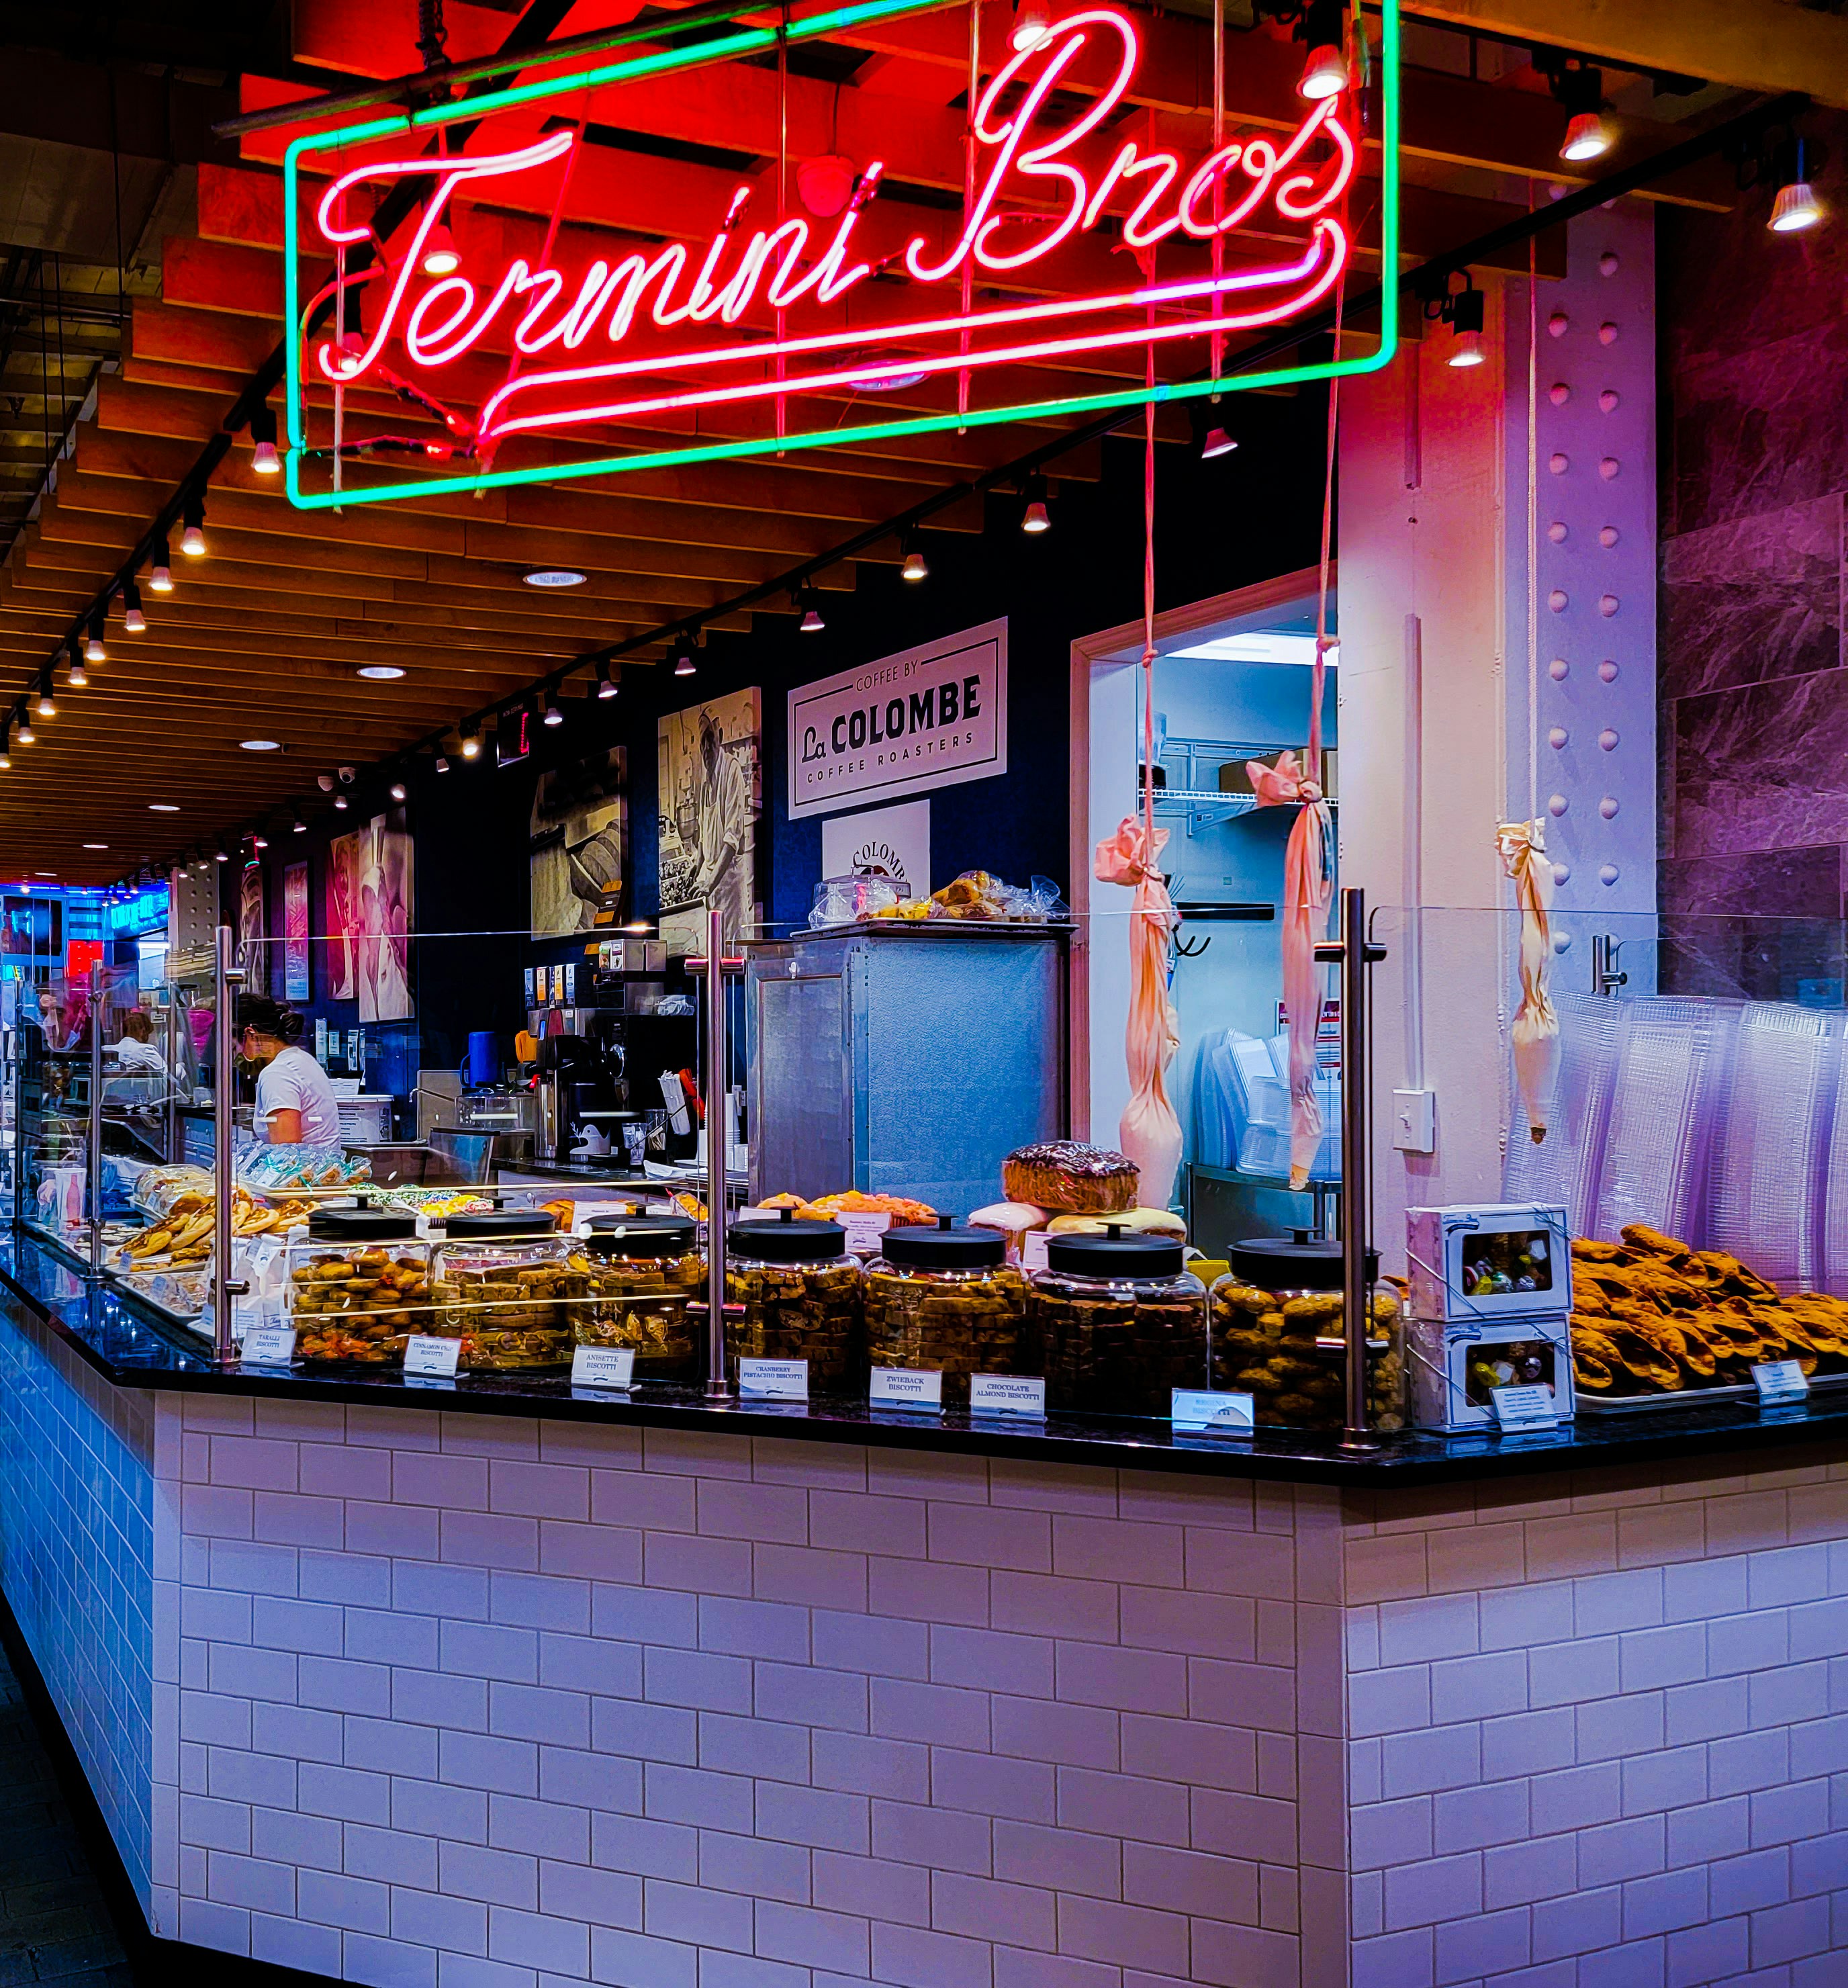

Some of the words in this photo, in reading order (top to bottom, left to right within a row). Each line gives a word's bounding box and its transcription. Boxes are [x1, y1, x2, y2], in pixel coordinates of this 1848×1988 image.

[318, 130, 874, 381] Termini
[907, 8, 1356, 281] Bros
[856, 666, 898, 692] COFFEE
[904, 660, 919, 678] BY
[802, 726, 826, 763] La
[832, 674, 982, 754] COLOMBE
[807, 760, 866, 784] COFFEE
[878, 732, 973, 766] ROASTERS
[853, 842, 907, 882] COLOMB
[586, 1354, 619, 1363] ANISETTE
[586, 1362, 616, 1371] BISCOTTI
[886, 1376, 925, 1385] ZWIEBACK
[888, 1384, 922, 1392] BISCOTTI
[986, 1384, 1029, 1392] CHOCOLATE
[976, 1390, 1007, 1398] ALMOND
[1008, 1392, 1040, 1401] BISCOTTI
